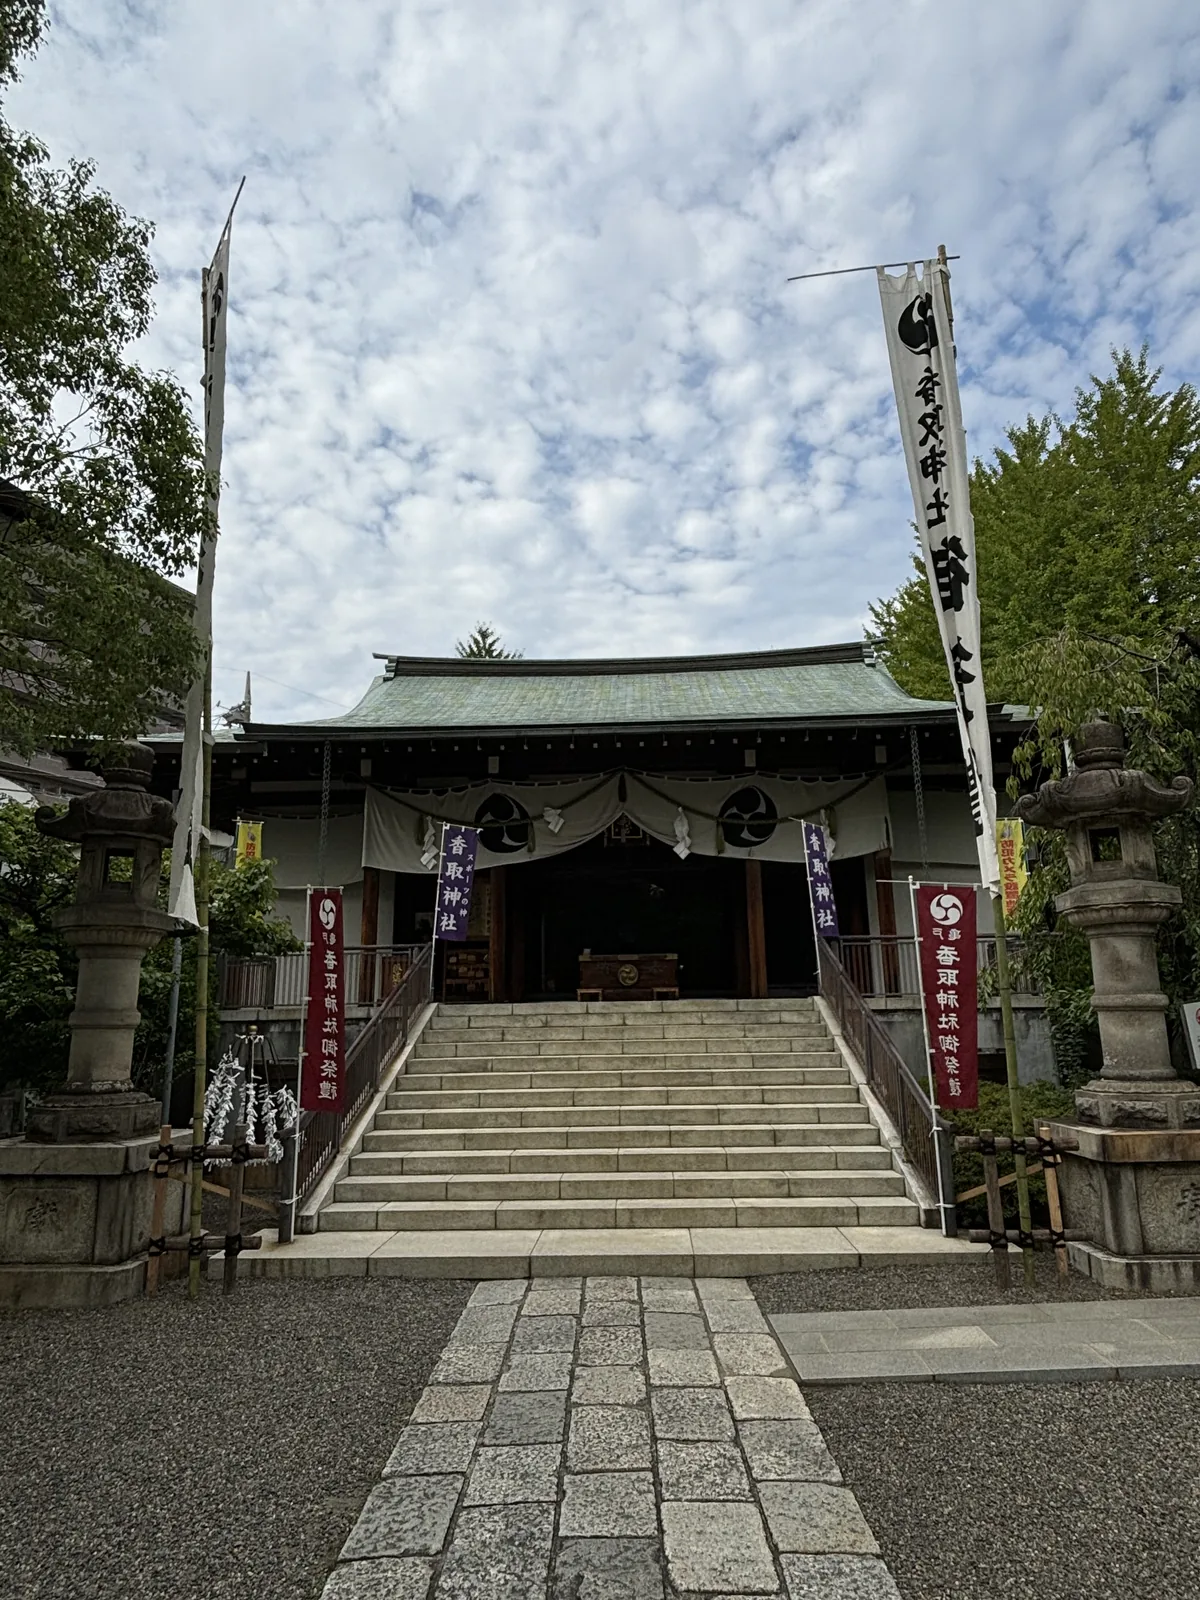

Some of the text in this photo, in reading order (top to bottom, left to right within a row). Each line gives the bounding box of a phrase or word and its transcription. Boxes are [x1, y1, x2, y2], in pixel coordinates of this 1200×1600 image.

[440, 835, 468, 932] 香取神社
[459, 853, 475, 918] スポーツの神
[808, 832, 836, 929] 香取神社
